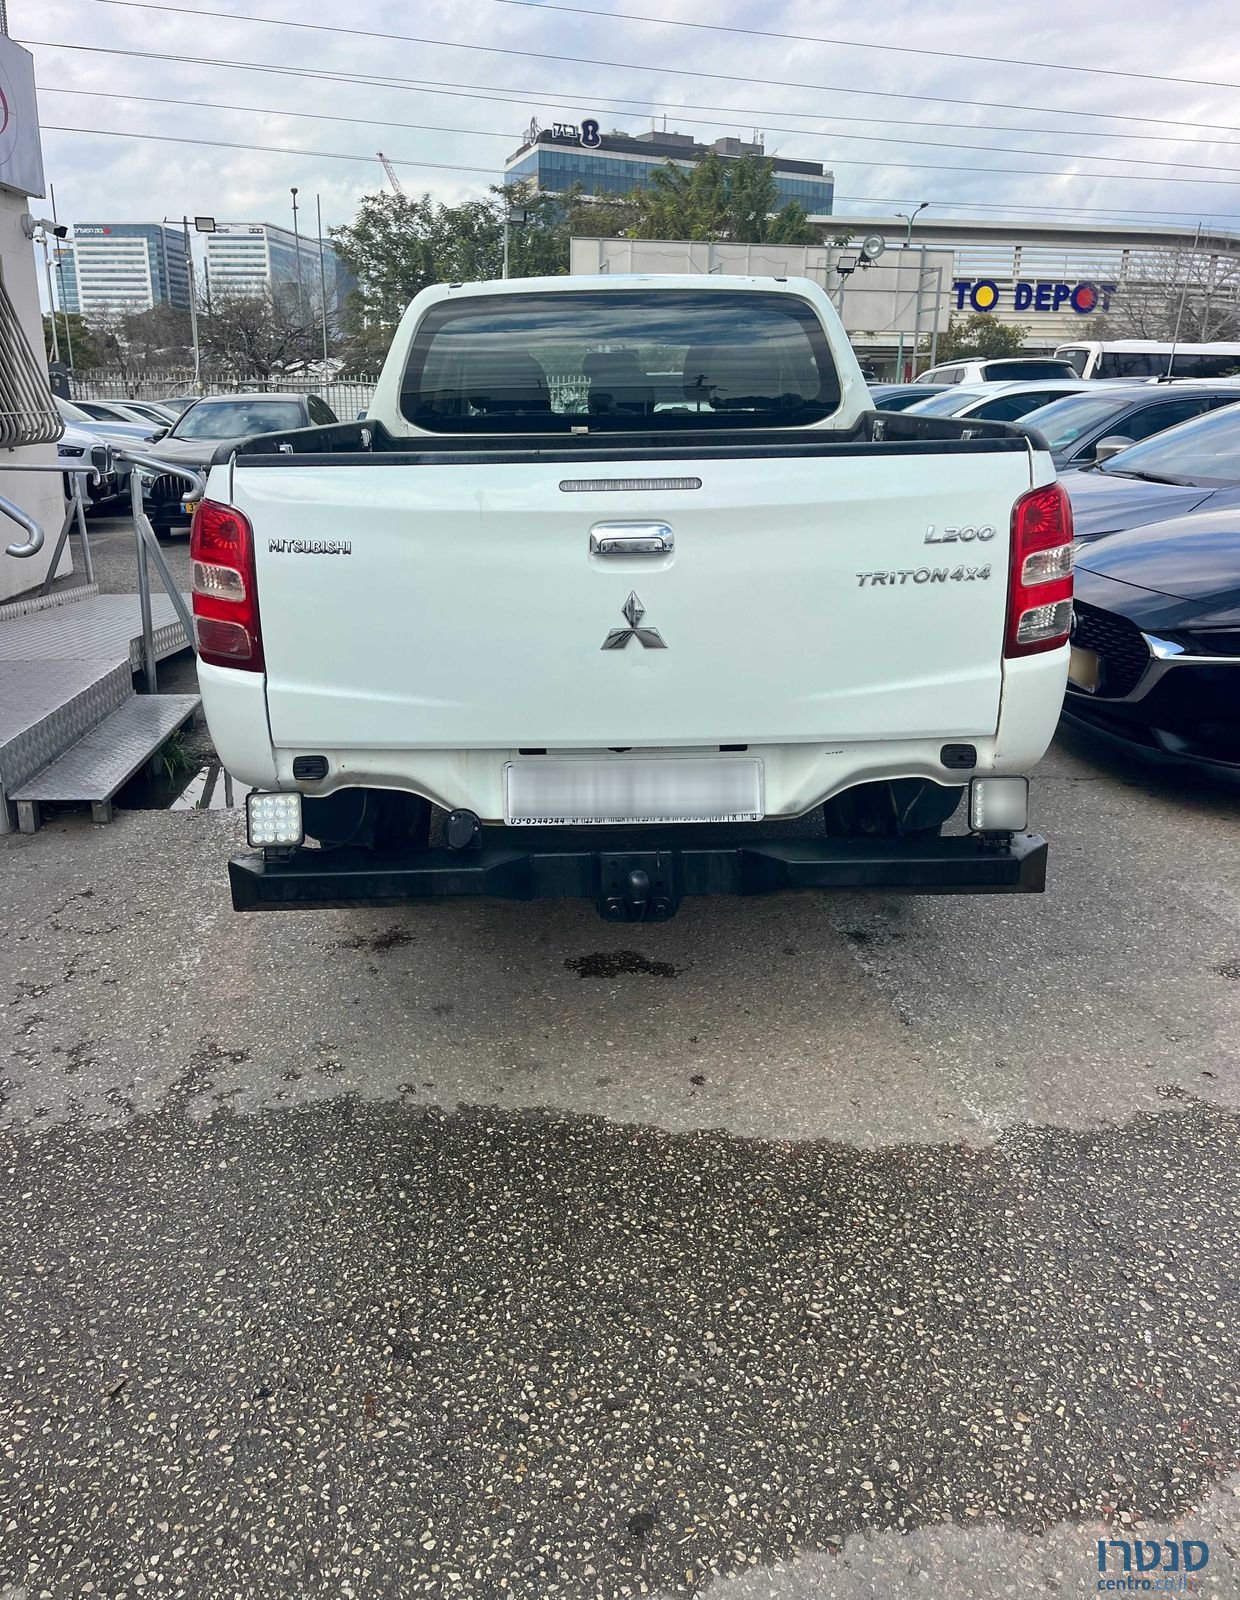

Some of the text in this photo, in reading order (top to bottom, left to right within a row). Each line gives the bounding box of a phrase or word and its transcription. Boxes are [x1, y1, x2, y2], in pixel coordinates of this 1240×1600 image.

[552, 122, 577, 138] בזק
[953, 279, 1118, 315] TO DEPOT
[923, 524, 997, 545] L200
[268, 538, 352, 555] MITSUBISHI
[855, 567, 949, 587] TRITON
